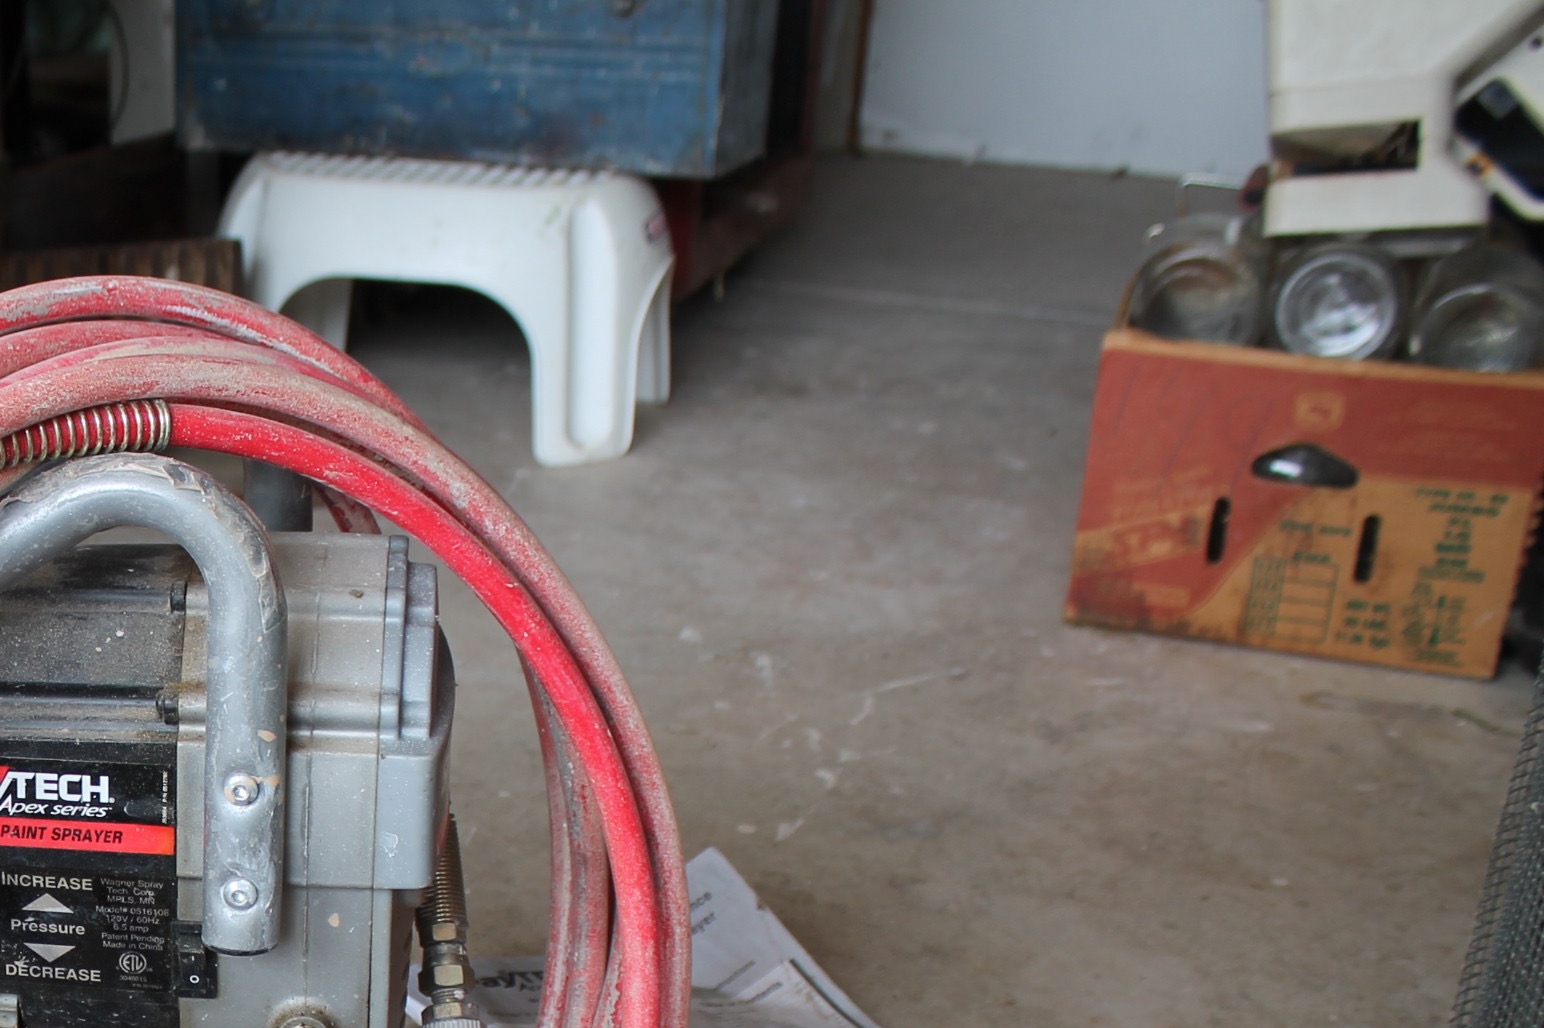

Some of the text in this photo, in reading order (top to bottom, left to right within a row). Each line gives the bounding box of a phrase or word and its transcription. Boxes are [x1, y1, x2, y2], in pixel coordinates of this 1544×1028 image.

[52, 803, 108, 818] series
[0, 825, 47, 840] PAINT
[51, 827, 123, 844] SPRAYER
[1, 871, 93, 891] INCREASE
[100, 878, 164, 889] Wagner Spray
[139, 897, 155, 905] MN
[96, 905, 128, 913] Model#
[106, 915, 129, 923] 120V
[136, 917, 160, 925] 60Hz
[10, 919, 86, 935] Pressure
[101, 932, 165, 944] Patent Pending
[138, 942, 164, 951] China
[5, 964, 101, 982] DECREASE
